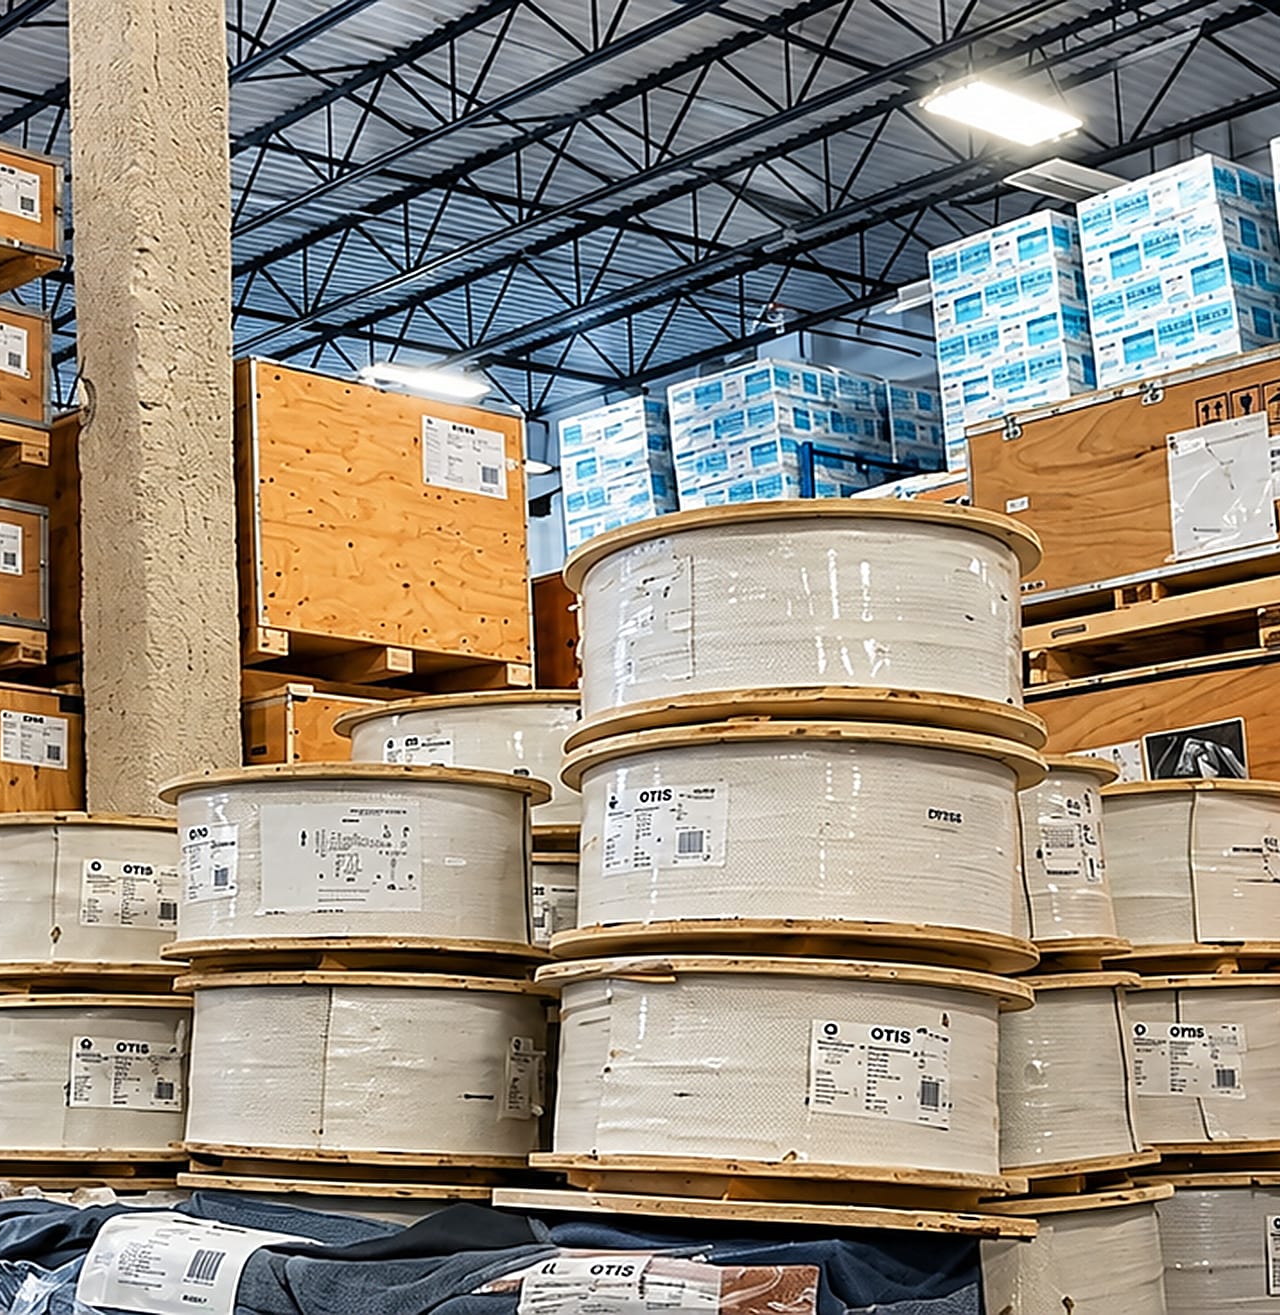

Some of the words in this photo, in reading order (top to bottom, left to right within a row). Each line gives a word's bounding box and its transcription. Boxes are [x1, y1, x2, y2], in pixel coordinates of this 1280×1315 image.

[639, 789, 672, 803] OTIS
[123, 864, 153, 875] OTIS
[871, 1027, 911, 1044] OTIS
[590, 1264, 634, 1277] OTIS
